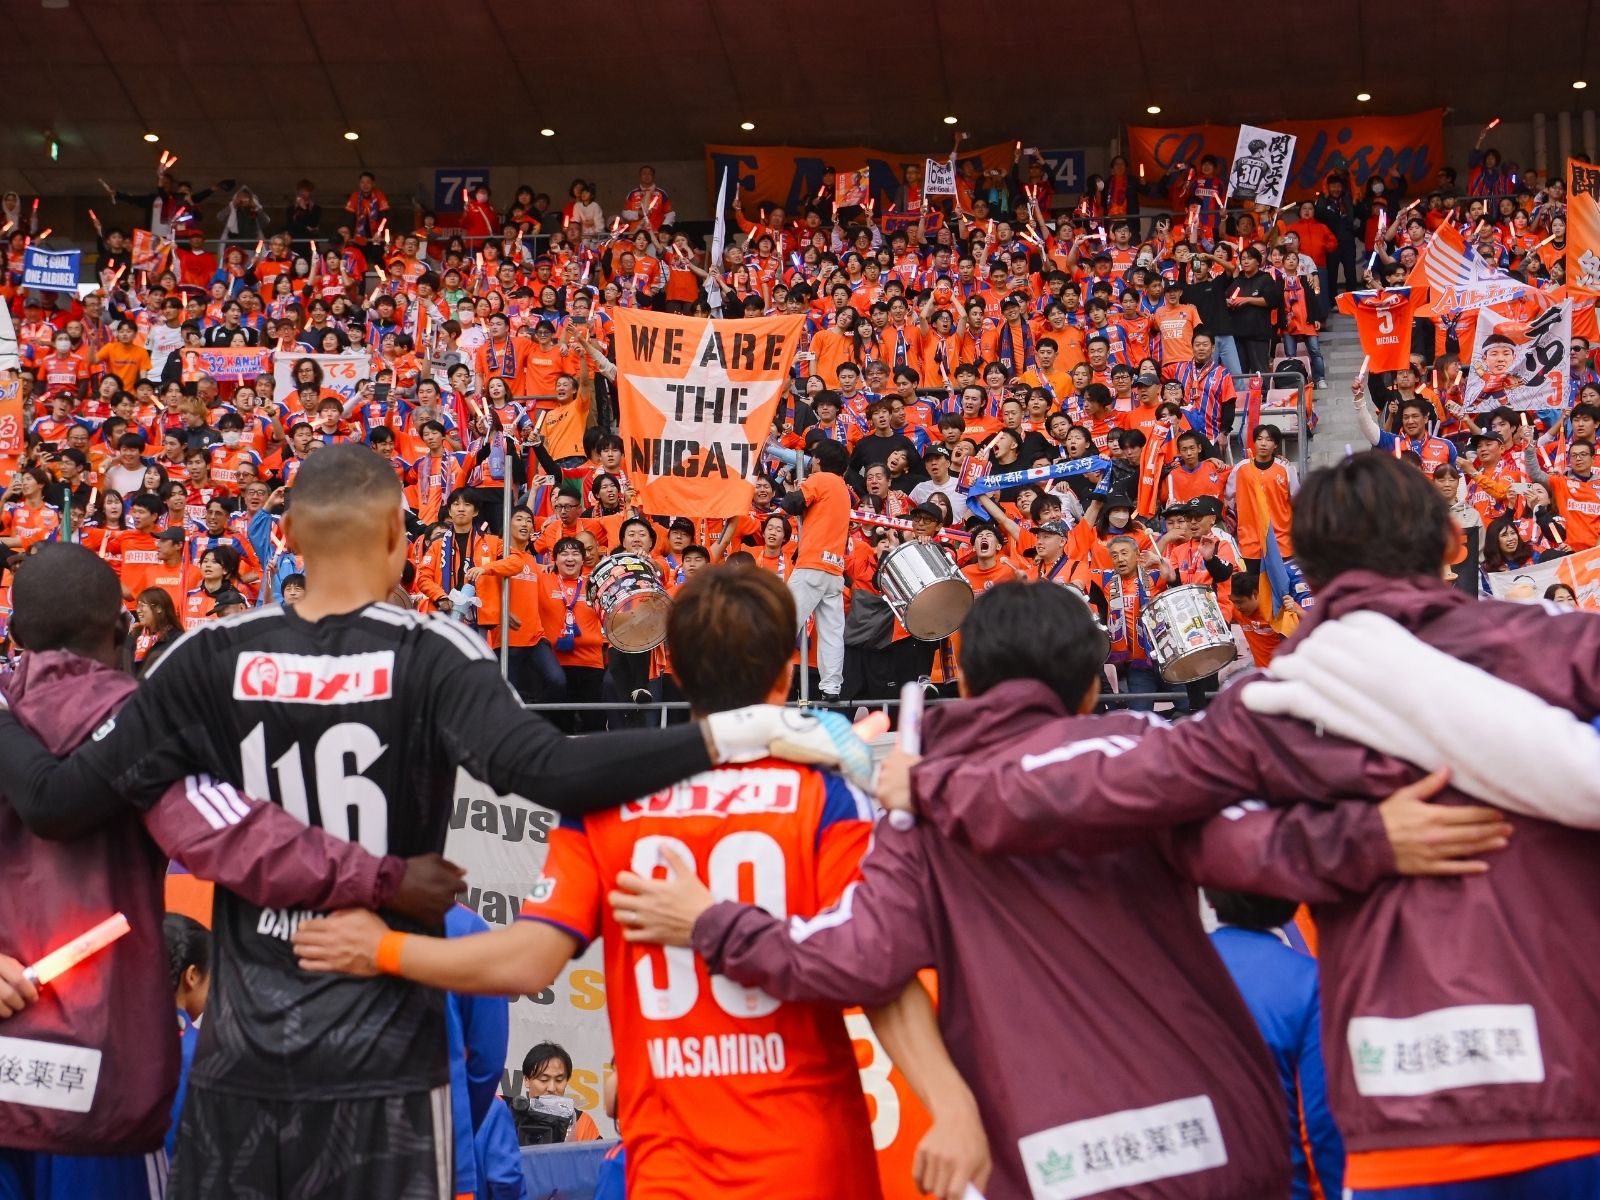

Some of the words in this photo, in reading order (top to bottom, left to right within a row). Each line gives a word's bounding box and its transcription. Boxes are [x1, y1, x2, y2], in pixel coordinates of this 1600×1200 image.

[1239, 165, 1261, 185] 30
[1262, 135, 1291, 195] 関口正大
[25, 269, 41, 283] ONE
[32, 253, 48, 268] ONE
[1376, 307, 1394, 334] 5
[630, 324, 683, 365] WE
[700, 331, 785, 370] ARE
[208, 357, 224, 373] 32
[227, 356, 260, 367] KANJI
[1546, 371, 1563, 406] 3
[666, 384, 748, 425] THE
[647, 1033, 786, 1079] MASAHIRO
